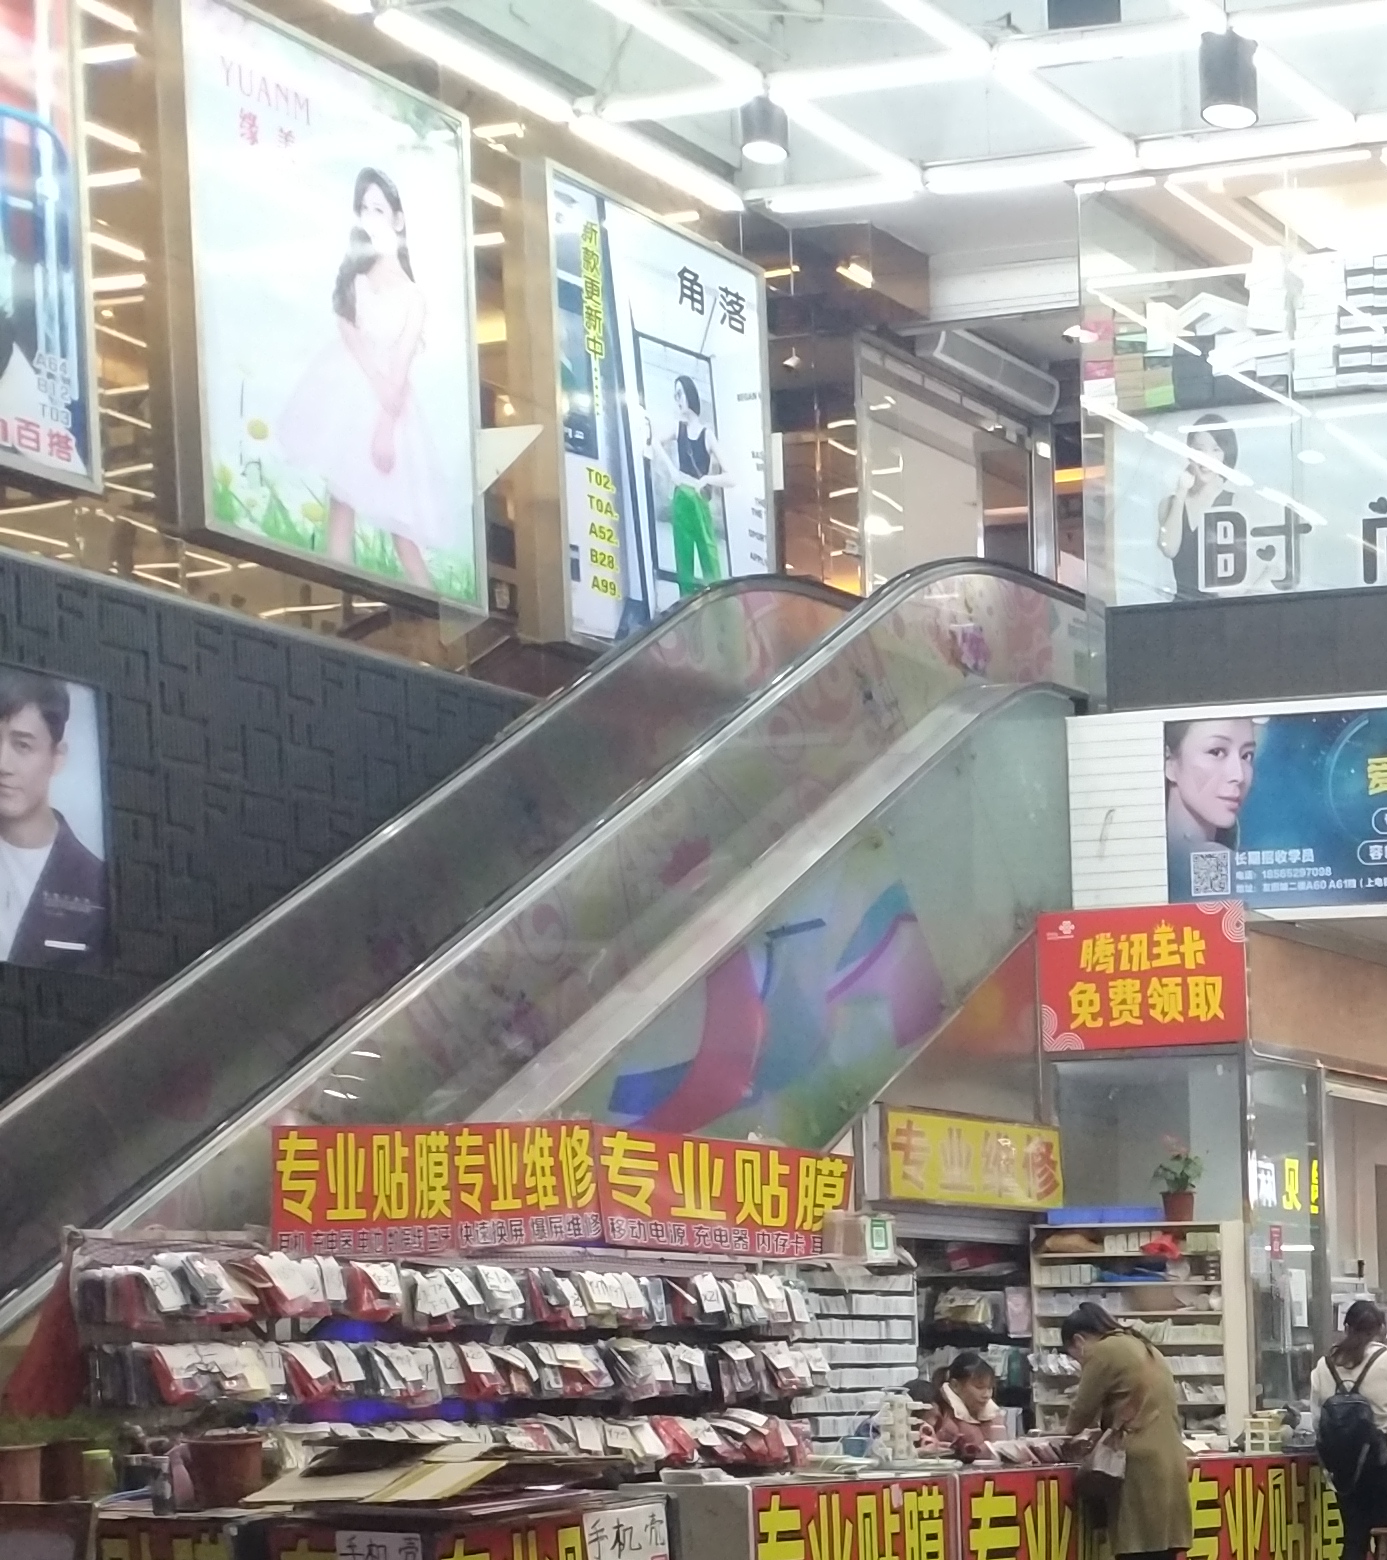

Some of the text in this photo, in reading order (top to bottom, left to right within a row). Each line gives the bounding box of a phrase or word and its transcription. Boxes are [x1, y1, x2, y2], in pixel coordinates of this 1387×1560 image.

[677, 265, 746, 334] 角落
[0, 417, 73, 462] 百搭
[1080, 920, 1206, 974] 腾讯王卡
[1068, 976, 1225, 1030] 免费领取
[275, 1130, 452, 1224] 专业贴膜
[454, 1125, 598, 1215] 专业维修
[600, 1131, 848, 1232] 专业贴膜
[459, 1217, 526, 1248] 快速换屏
[608, 1216, 688, 1246] 移动电源
[693, 1225, 750, 1251] 充电器
[756, 1231, 806, 1257] 内存卡
[588, 1513, 666, 1560] 手机壳
